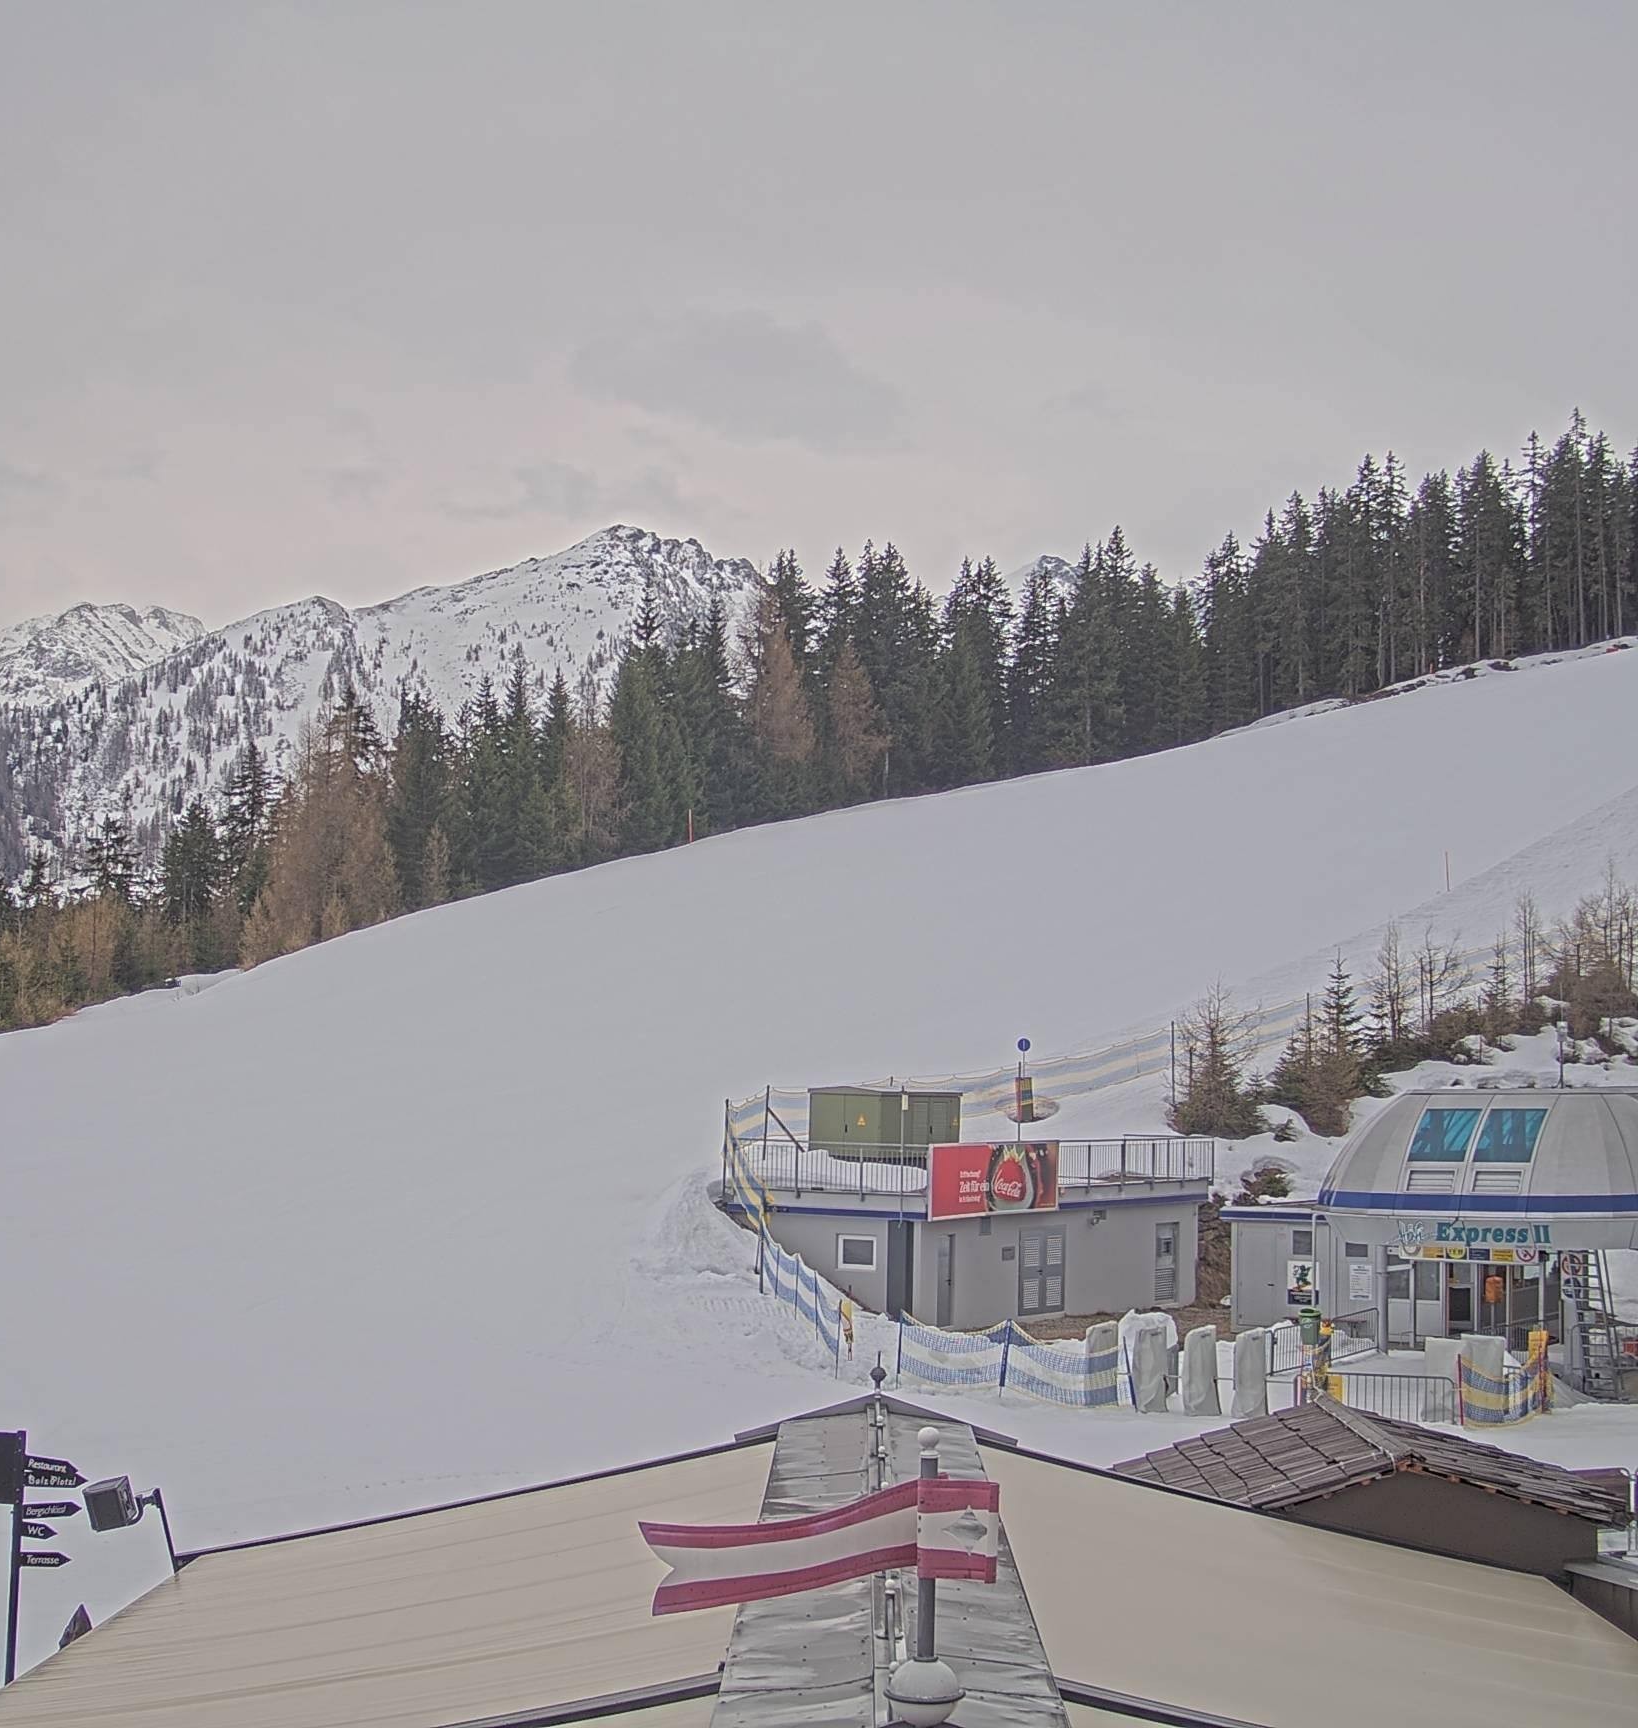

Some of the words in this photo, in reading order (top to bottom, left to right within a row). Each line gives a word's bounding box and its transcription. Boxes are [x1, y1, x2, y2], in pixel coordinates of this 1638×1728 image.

[1436, 1222, 1529, 1247] Express
[27, 1525, 45, 1536] WC
[26, 1554, 60, 1565] Terrasse
